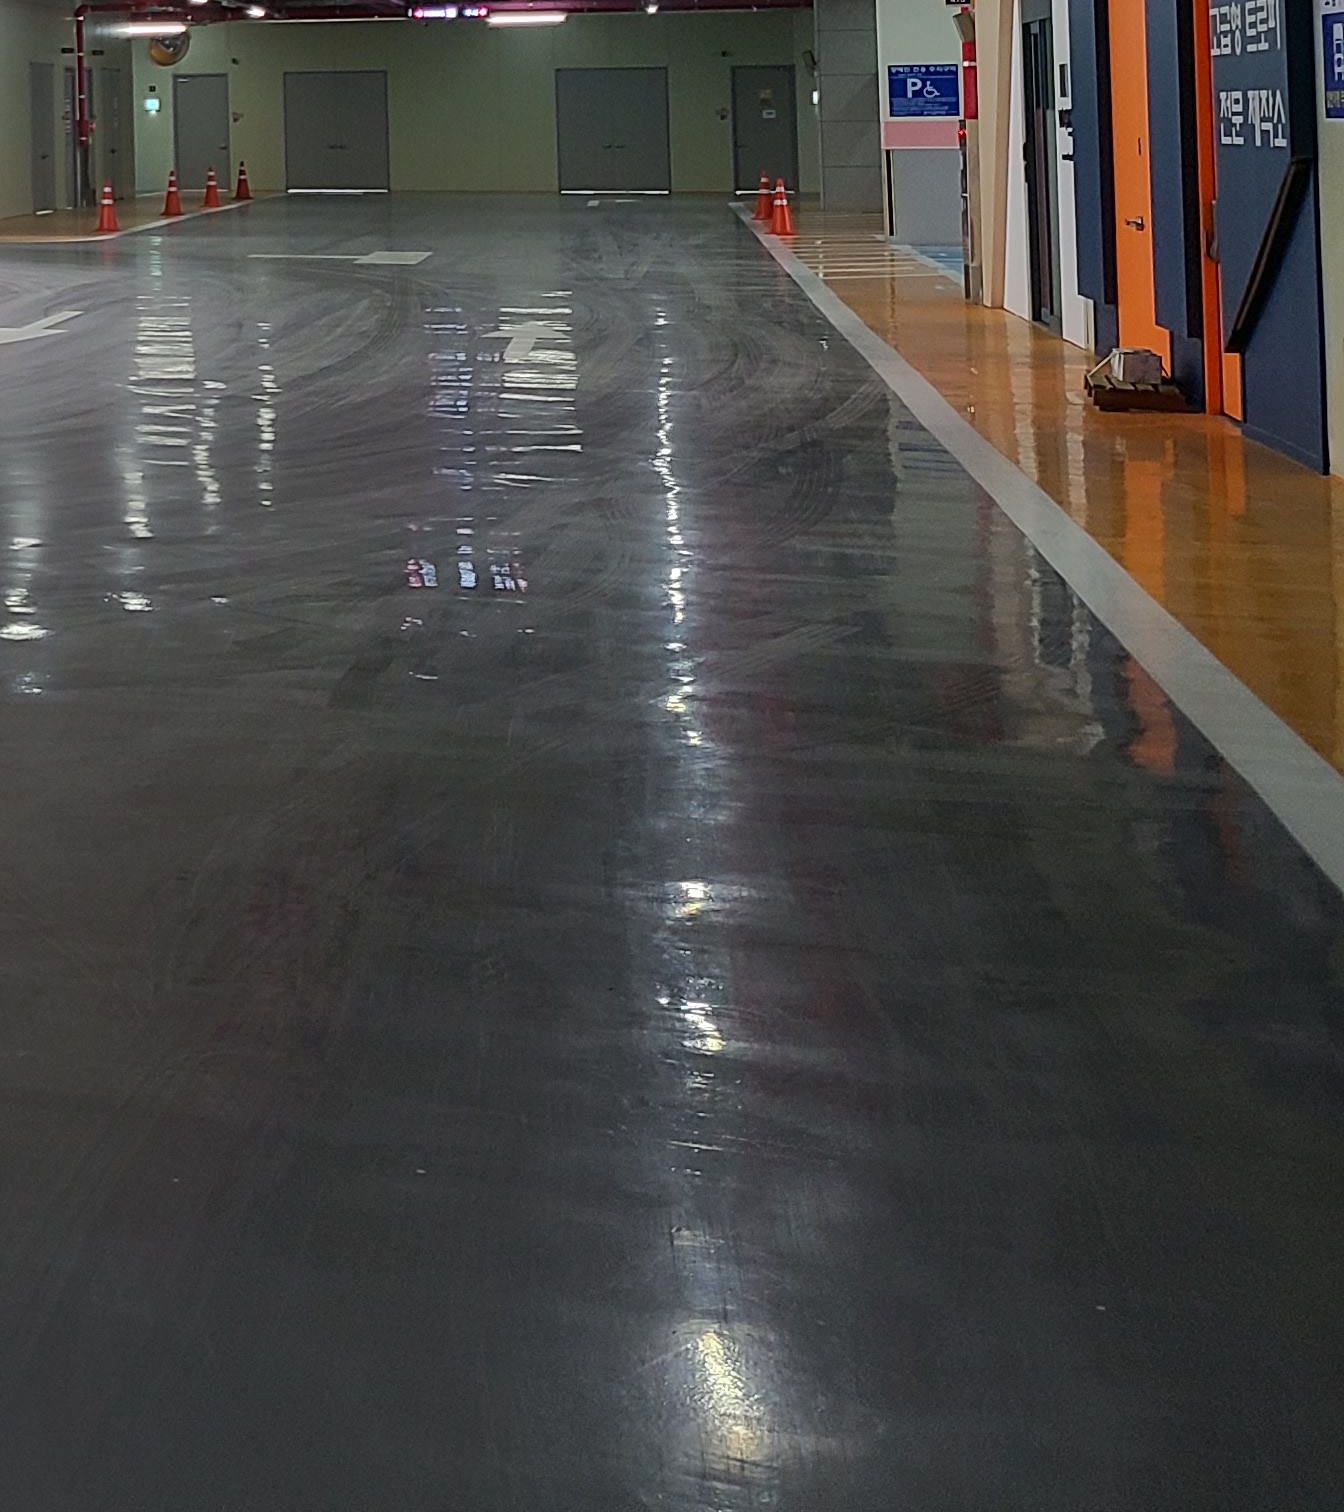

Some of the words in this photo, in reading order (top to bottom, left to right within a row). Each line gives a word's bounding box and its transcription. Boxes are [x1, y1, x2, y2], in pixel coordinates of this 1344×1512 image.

[1209, 1, 1242, 56] 고급형
[906, 78, 923, 99] P
[1219, 90, 1245, 145] 전문
[1247, 89, 1288, 148] 제작소
